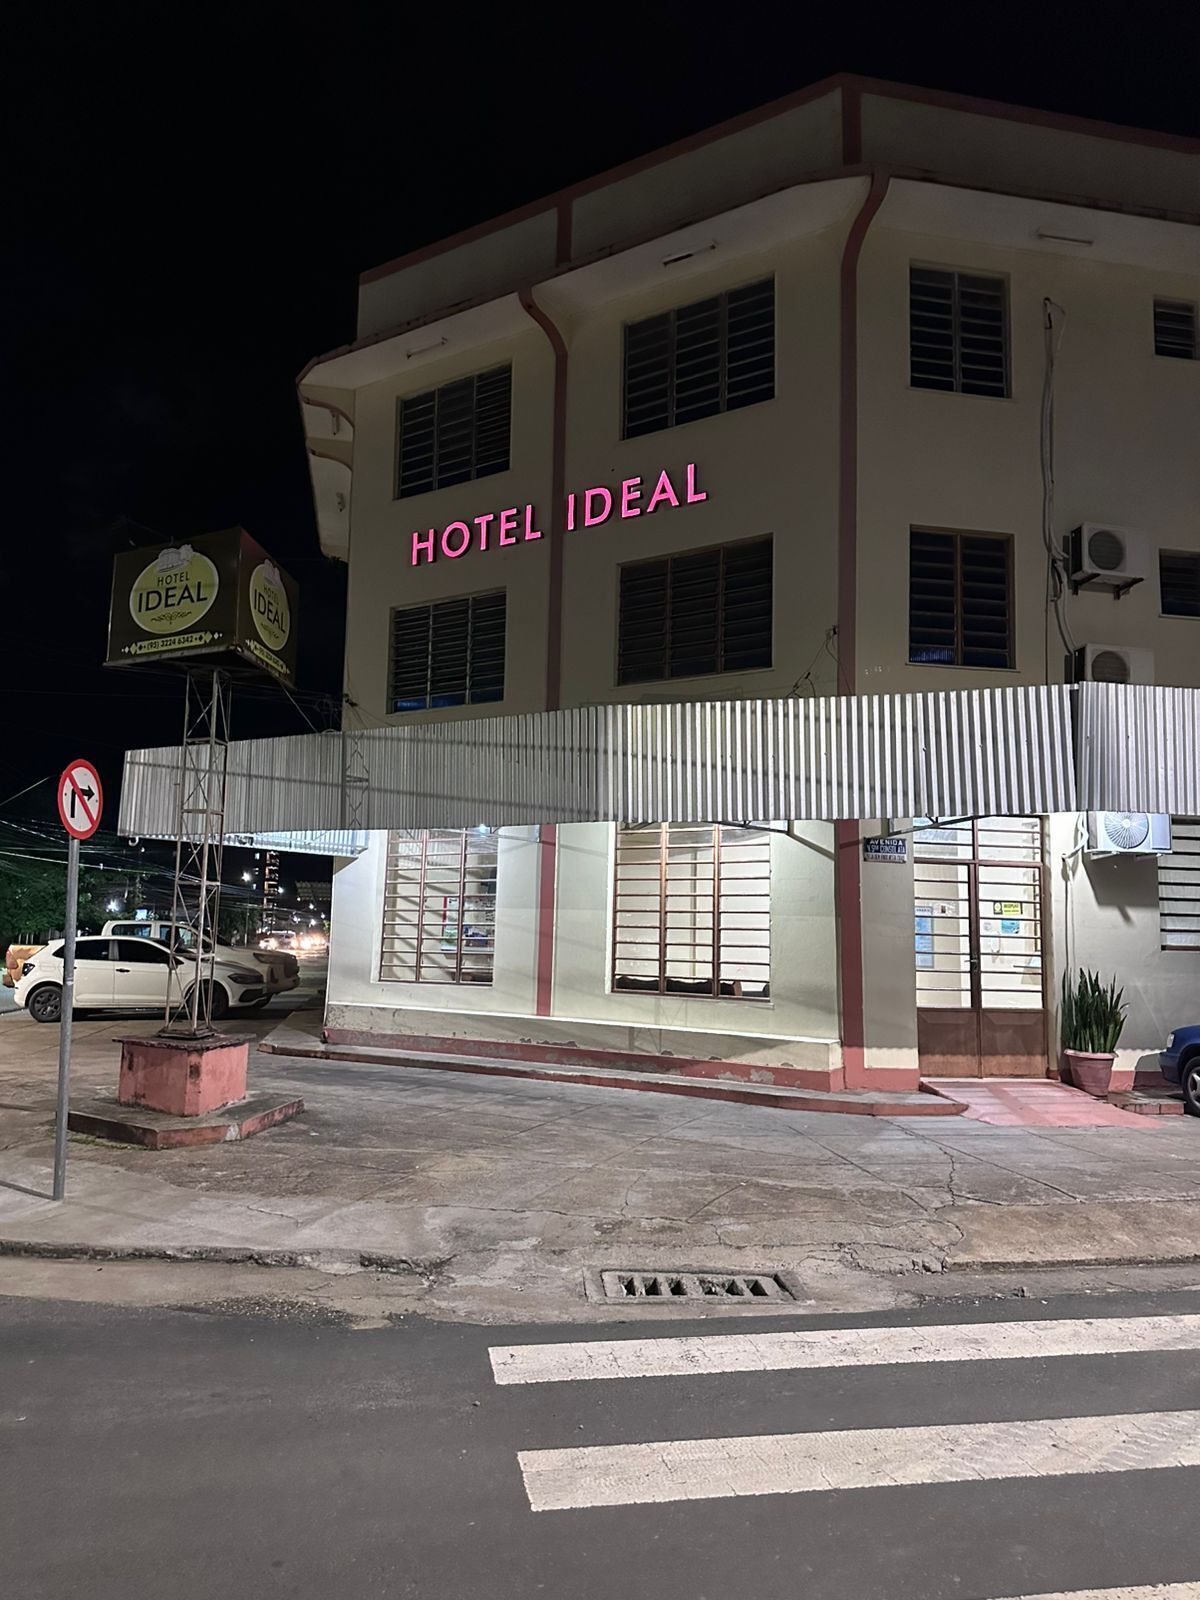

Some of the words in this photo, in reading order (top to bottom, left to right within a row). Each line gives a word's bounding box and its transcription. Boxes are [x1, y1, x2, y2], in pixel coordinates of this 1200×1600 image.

[411, 504, 542, 566] HOTEL
[567, 463, 707, 531] IDEAL
[138, 581, 208, 613] IDEAL
[157, 571, 190, 587] HOTEL
[254, 588, 286, 634] IDEAL
